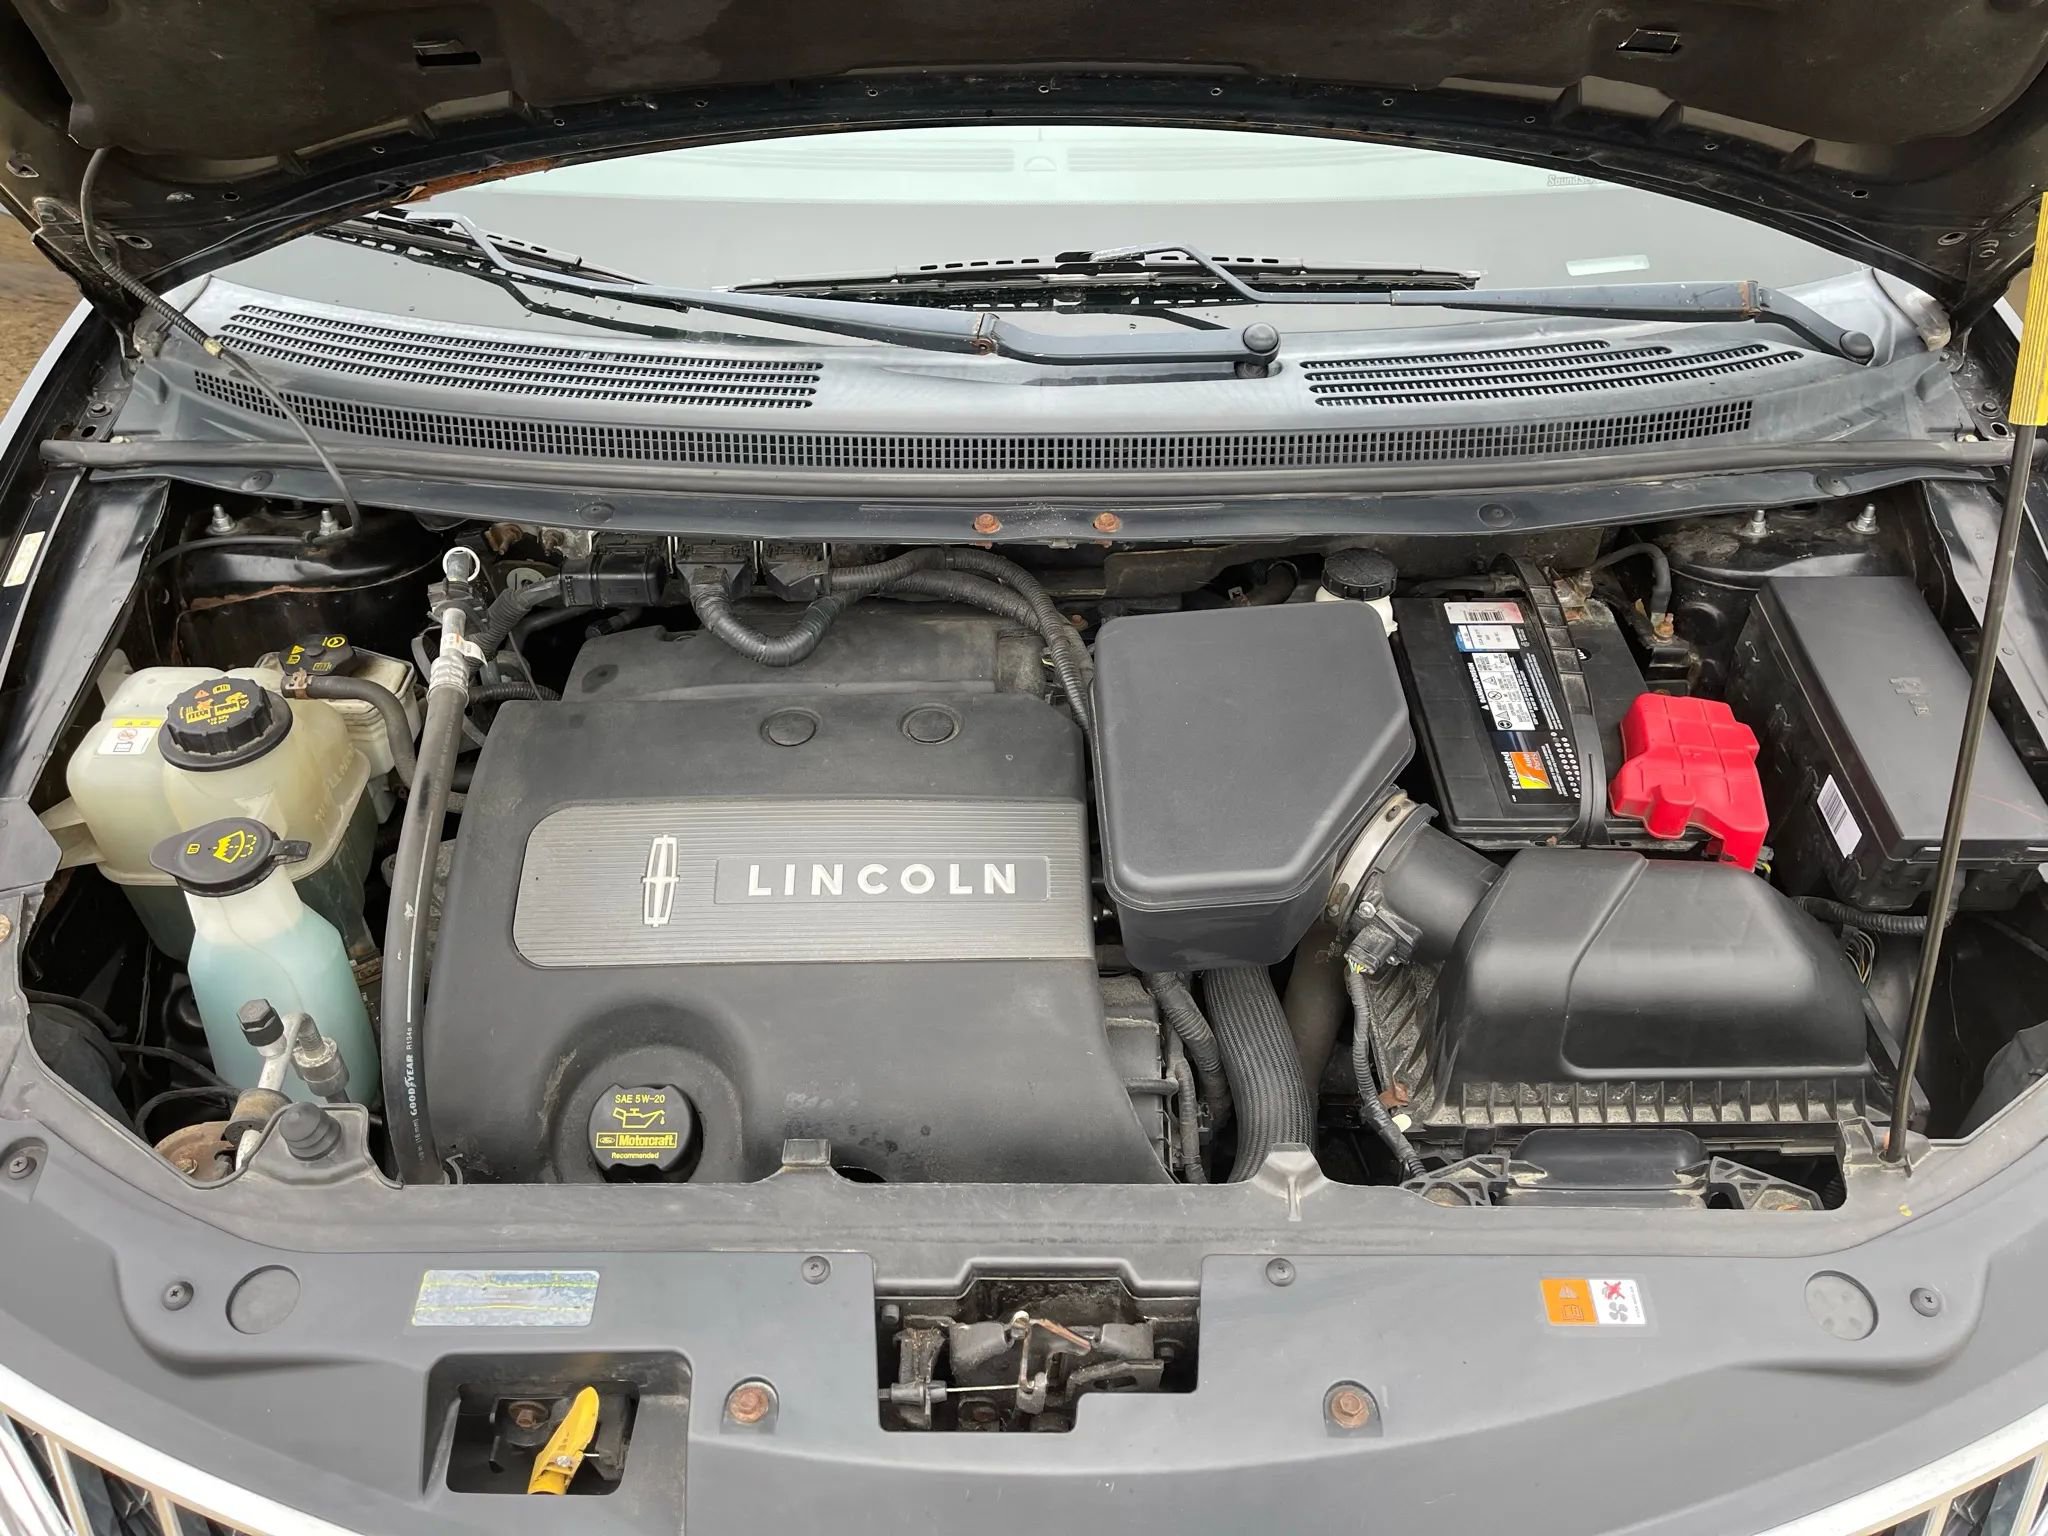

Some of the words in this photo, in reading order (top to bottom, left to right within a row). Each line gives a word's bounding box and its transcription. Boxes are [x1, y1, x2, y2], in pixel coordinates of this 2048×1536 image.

[1500, 751, 1520, 789] Federated
[1523, 753, 1533, 767] Auto
[748, 863, 1016, 896] LINCOLN
[404, 1054, 417, 1116] GOODYEAR
[615, 1094, 633, 1104] SAE
[635, 1094, 665, 1104] 5W-20
